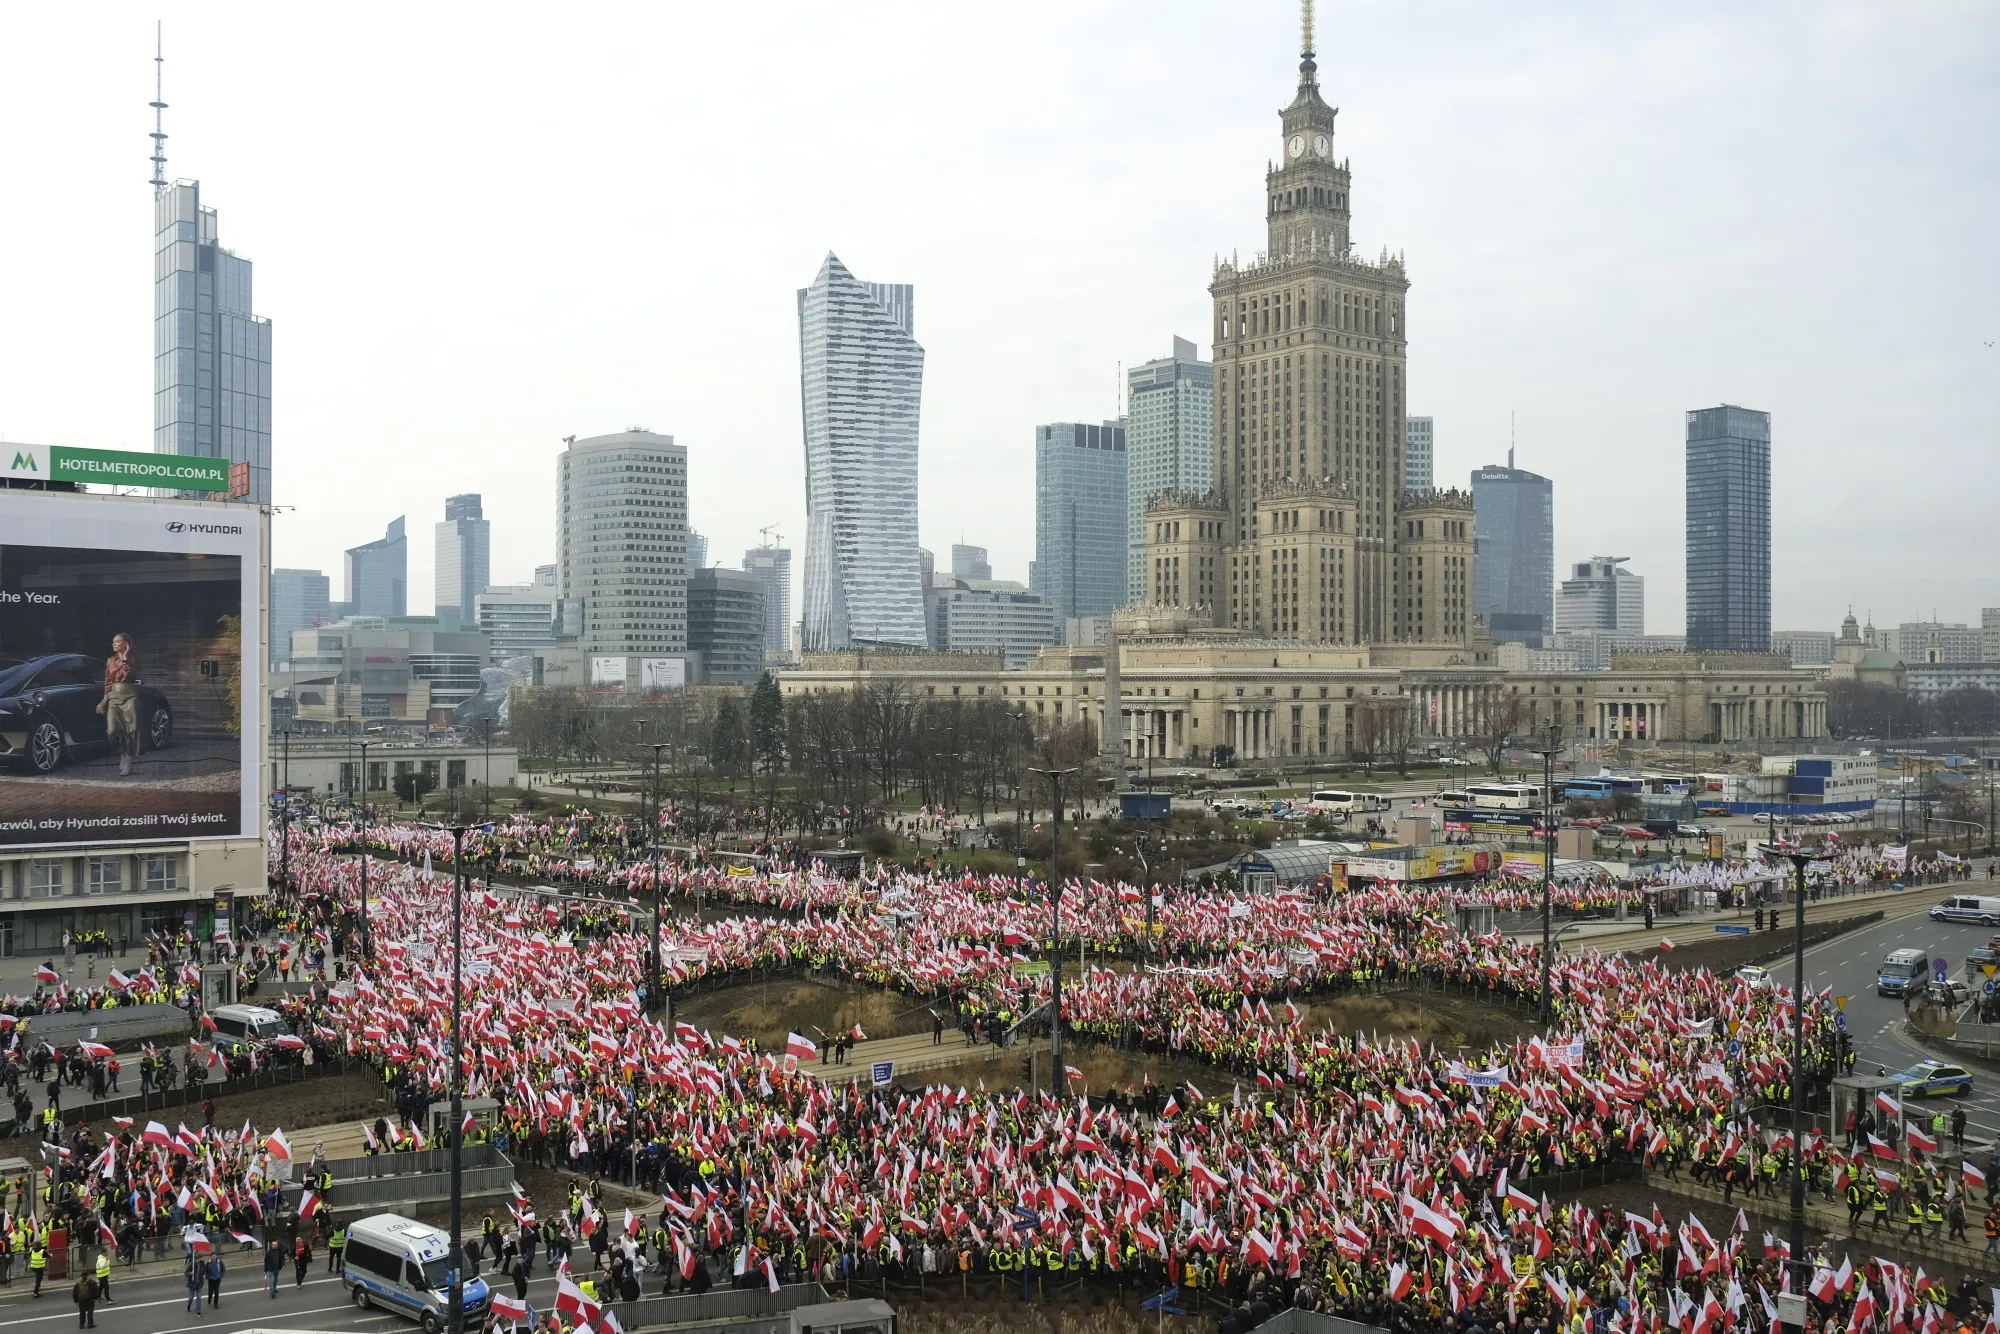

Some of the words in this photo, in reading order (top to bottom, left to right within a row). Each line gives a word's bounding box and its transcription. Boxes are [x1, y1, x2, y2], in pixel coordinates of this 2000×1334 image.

[60, 458, 224, 480] HOTELMETROPOL.COM.PL
[189, 523, 242, 535] HYUNDAI
[24, 591, 61, 604] Year.
[39, 818, 64, 830] aby
[66, 815, 120, 829] Hyundai
[122, 814, 158, 826] zasilił
[160, 813, 189, 825] Twój
[190, 812, 227, 823] świat.
